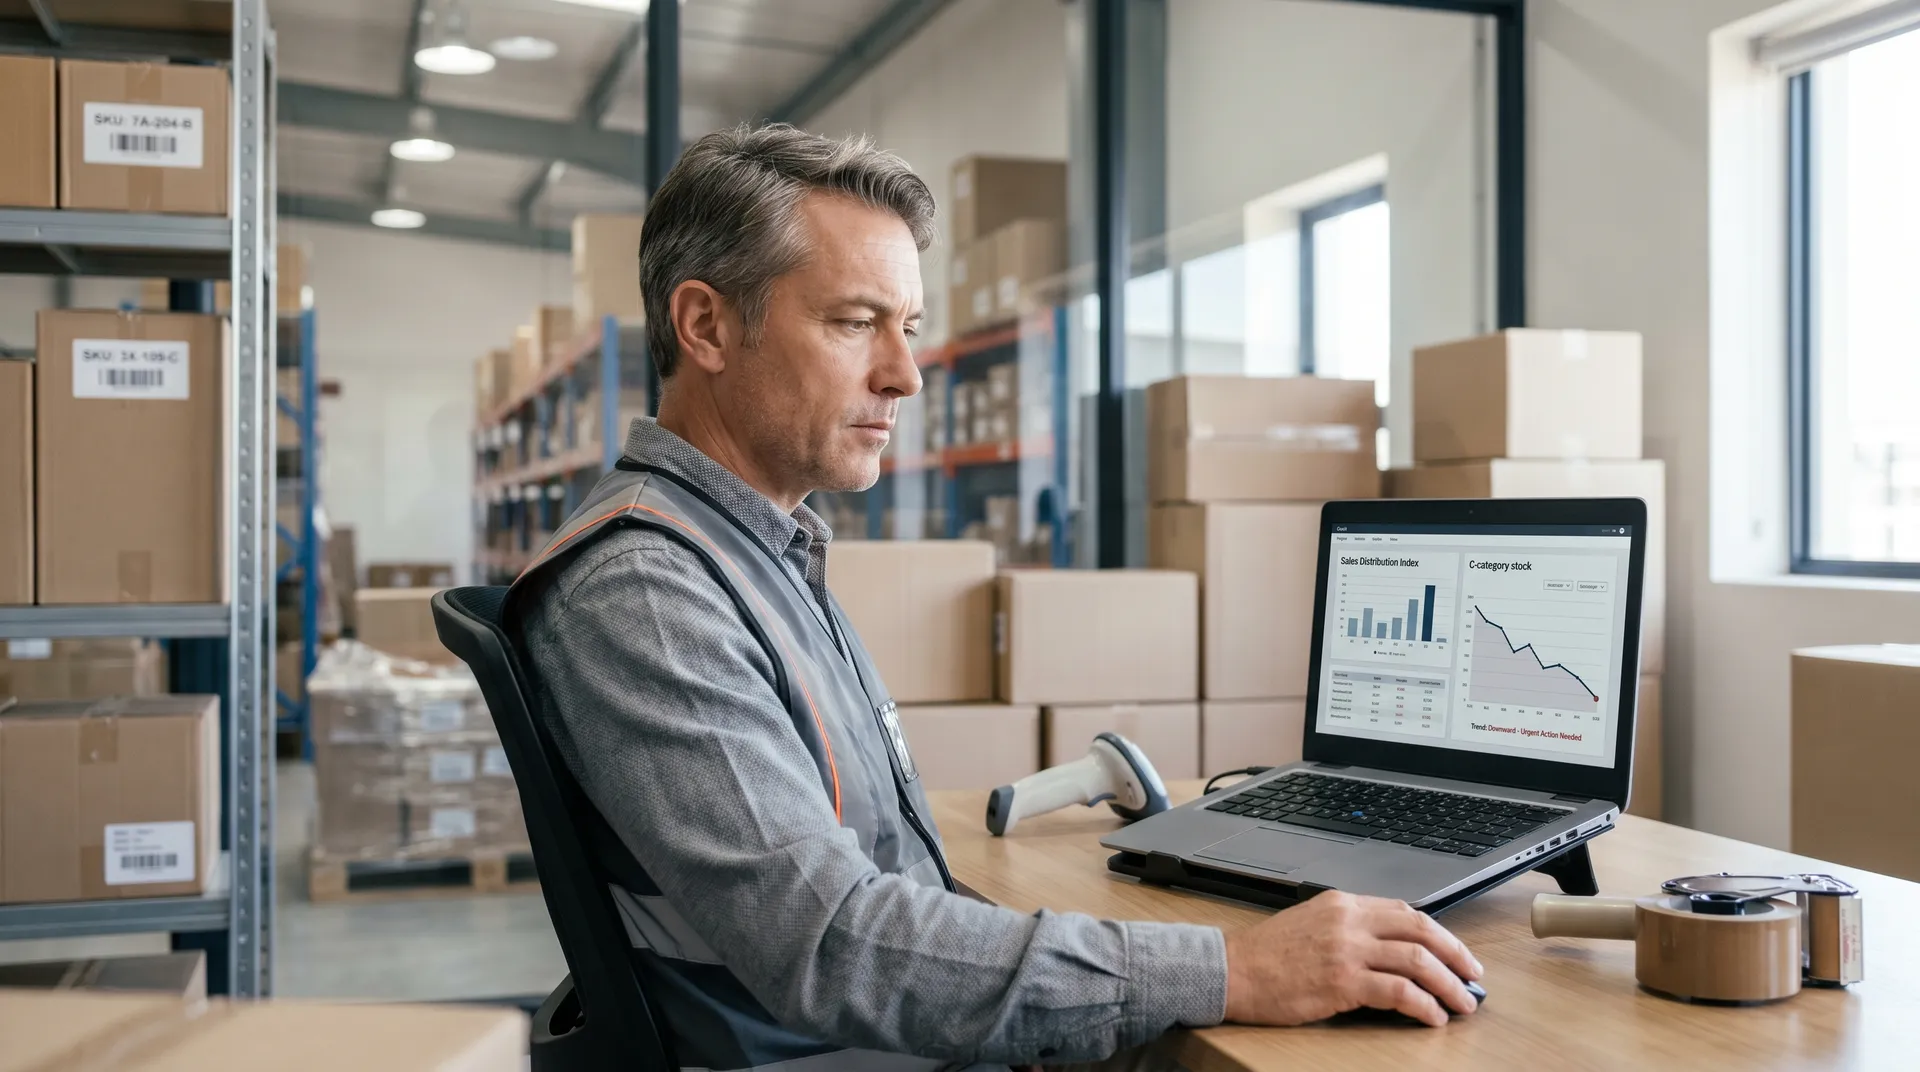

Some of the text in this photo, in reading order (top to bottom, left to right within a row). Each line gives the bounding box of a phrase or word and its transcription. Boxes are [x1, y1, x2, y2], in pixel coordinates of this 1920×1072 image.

[1340, 557, 1419, 568] Sales Distribution Index
[1469, 560, 1532, 572] C-category stock
[1471, 723, 1488, 732] Trend:
[1488, 724, 1517, 734] Downward
[1520, 728, 1540, 738] Urgent
[1540, 730, 1559, 739] Action
[1559, 732, 1582, 742] Needed
